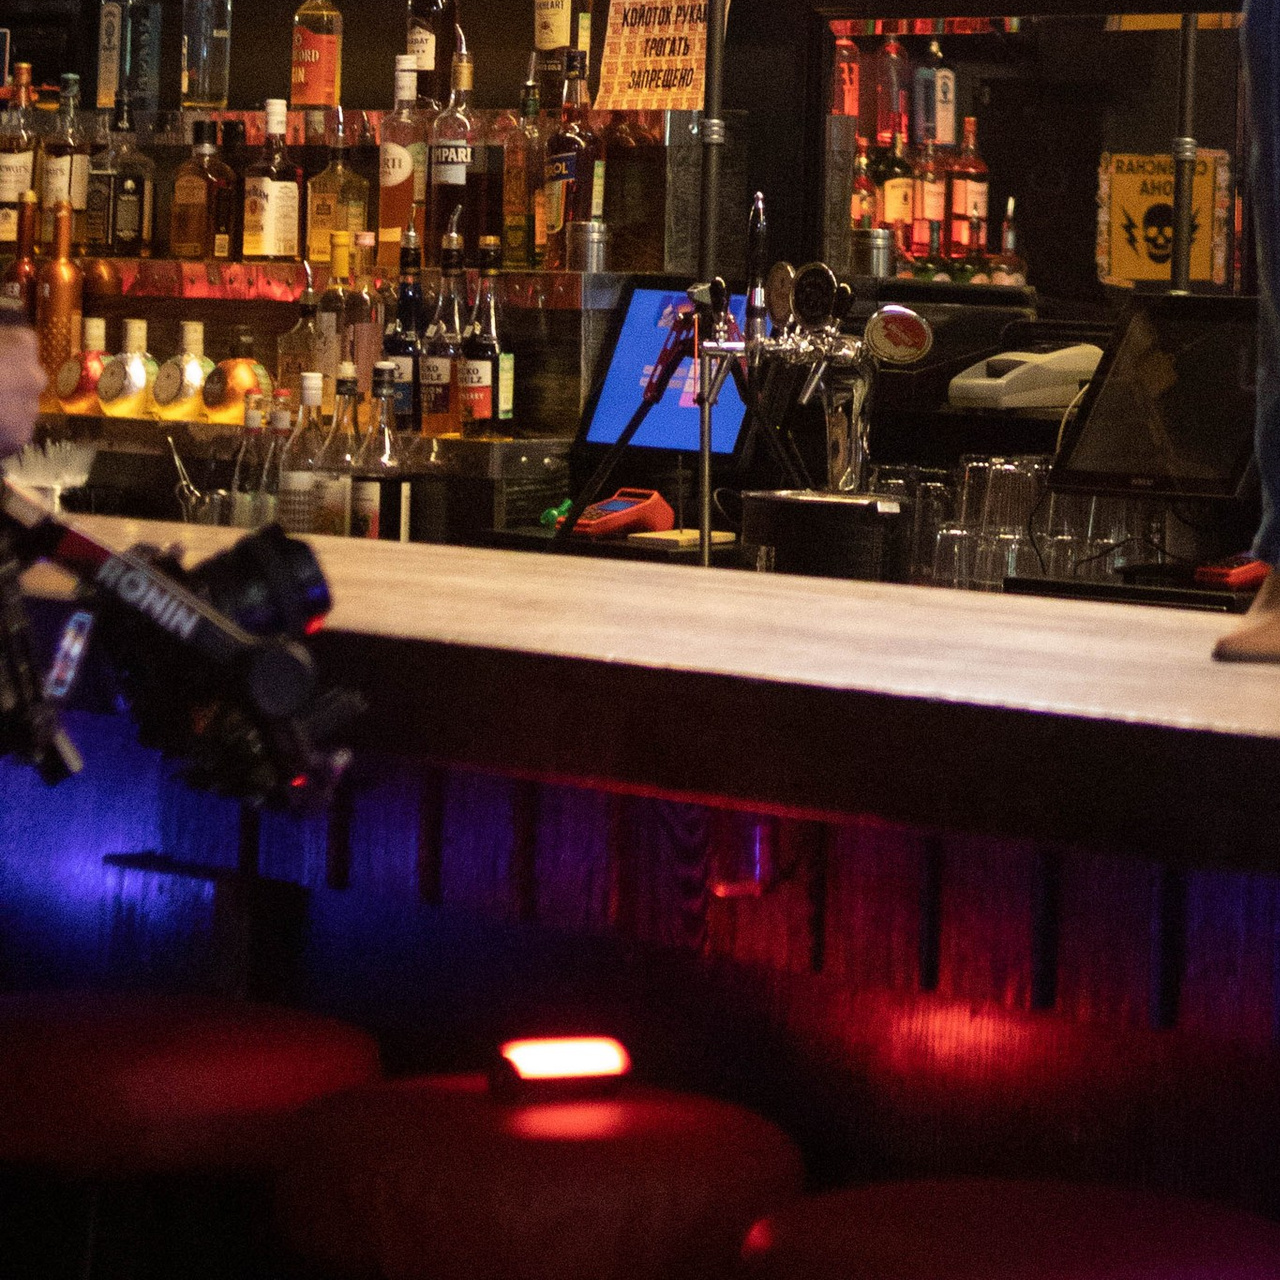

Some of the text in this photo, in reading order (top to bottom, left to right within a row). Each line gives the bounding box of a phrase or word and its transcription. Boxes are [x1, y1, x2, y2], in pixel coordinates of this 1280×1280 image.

[641, 37, 689, 58] ТРОГАТЬ
[628, 68, 694, 90] ЗАПРЕЩЕНО
[98, 555, 200, 639] RONIN
